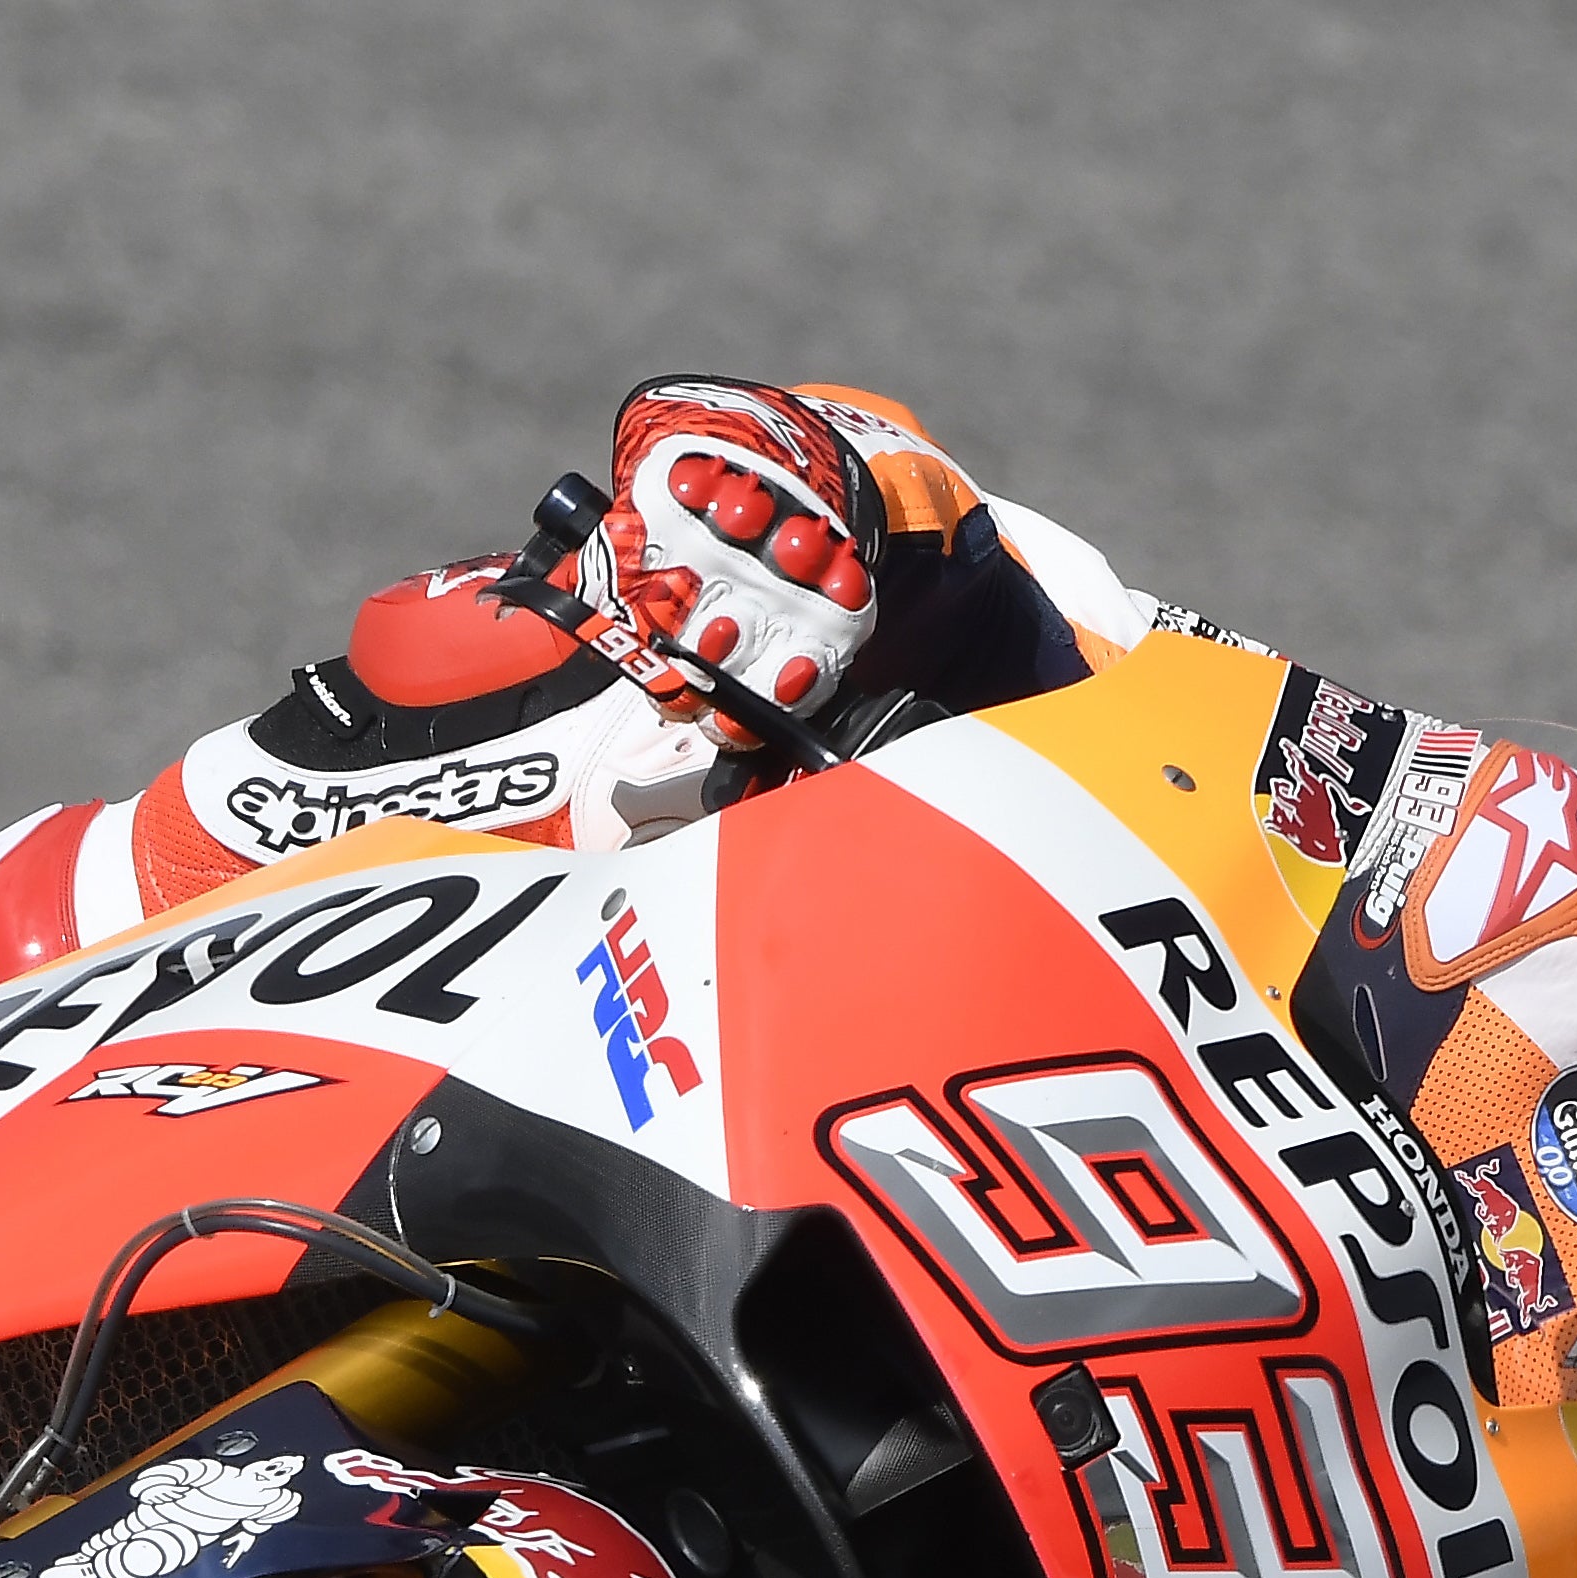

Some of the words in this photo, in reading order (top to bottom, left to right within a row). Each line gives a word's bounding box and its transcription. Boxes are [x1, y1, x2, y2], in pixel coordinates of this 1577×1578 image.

[590, 626, 670, 684] 93
[1392, 772, 1465, 836] 93
[1365, 838, 1426, 928] Puig
[1360, 1094, 1470, 1295] HONDA
